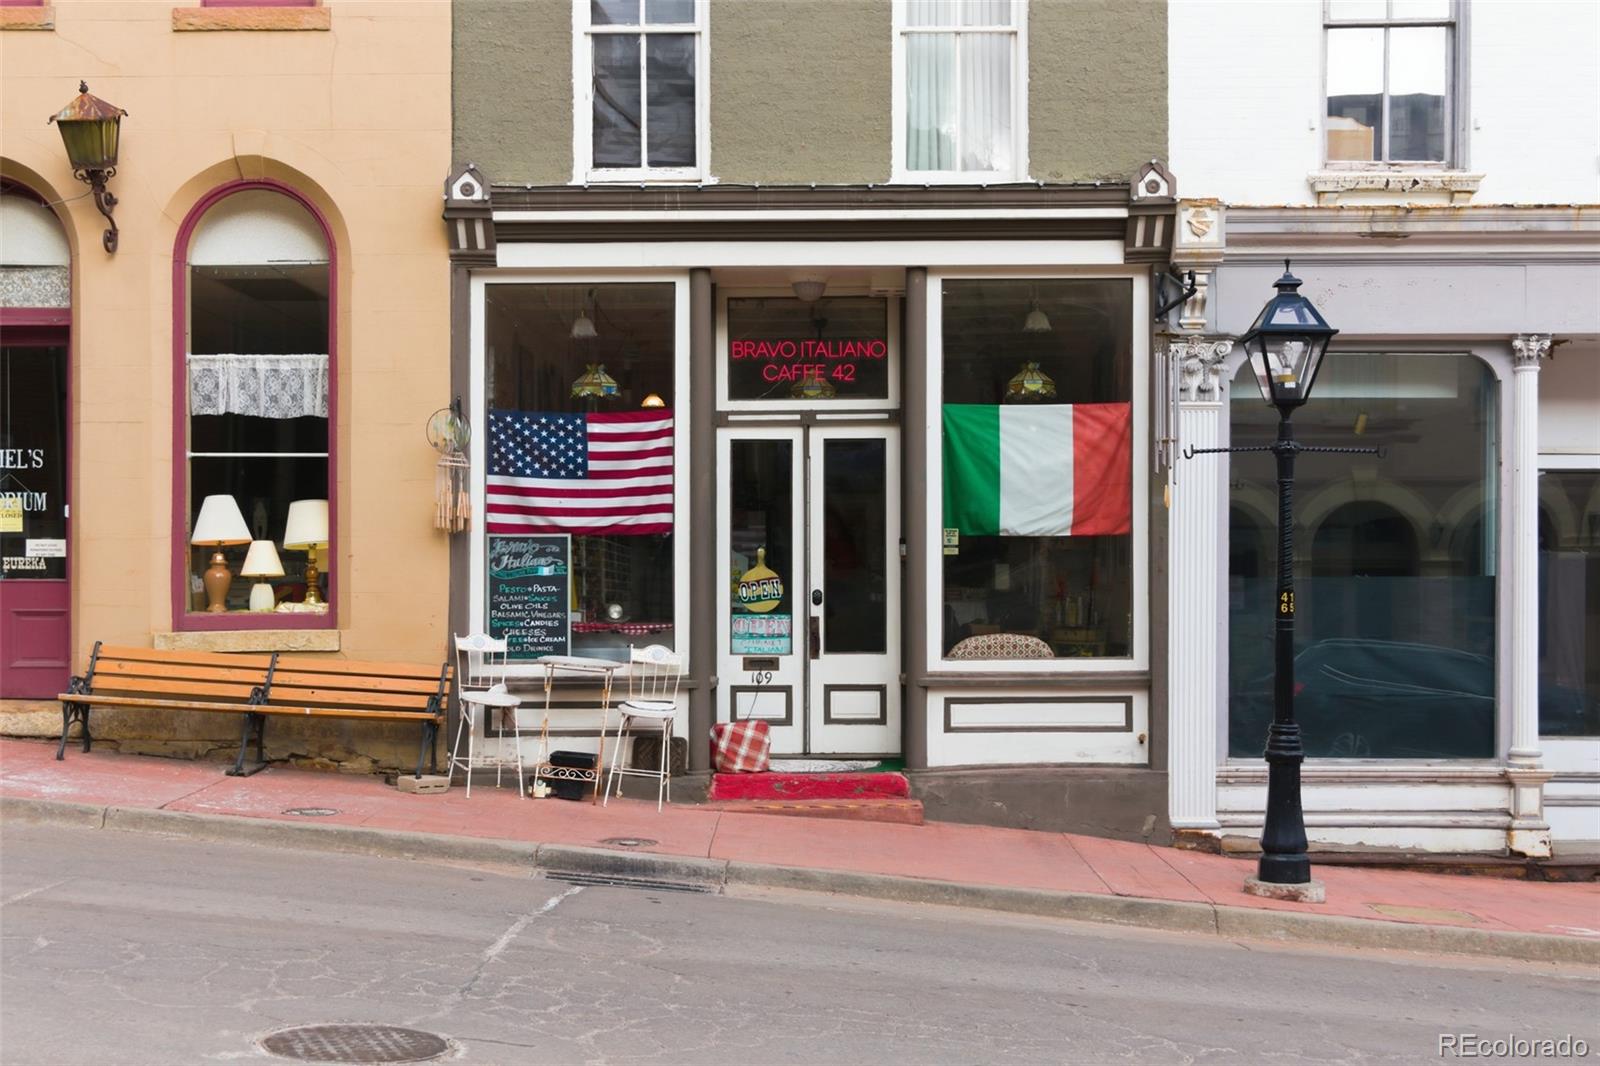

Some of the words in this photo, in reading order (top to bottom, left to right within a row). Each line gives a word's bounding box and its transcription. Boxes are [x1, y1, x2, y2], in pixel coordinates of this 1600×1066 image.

[732, 341, 796, 358] BRAVO
[801, 341, 887, 358] ITALIANO
[763, 364, 826, 381] CAFFE
[832, 364, 856, 381] 42
[2, 556, 47, 572] EUREKA
[740, 579, 782, 602] OPEN
[1281, 592, 1294, 602] 41
[734, 618, 792, 636] OPEN
[751, 671, 773, 685] 109
